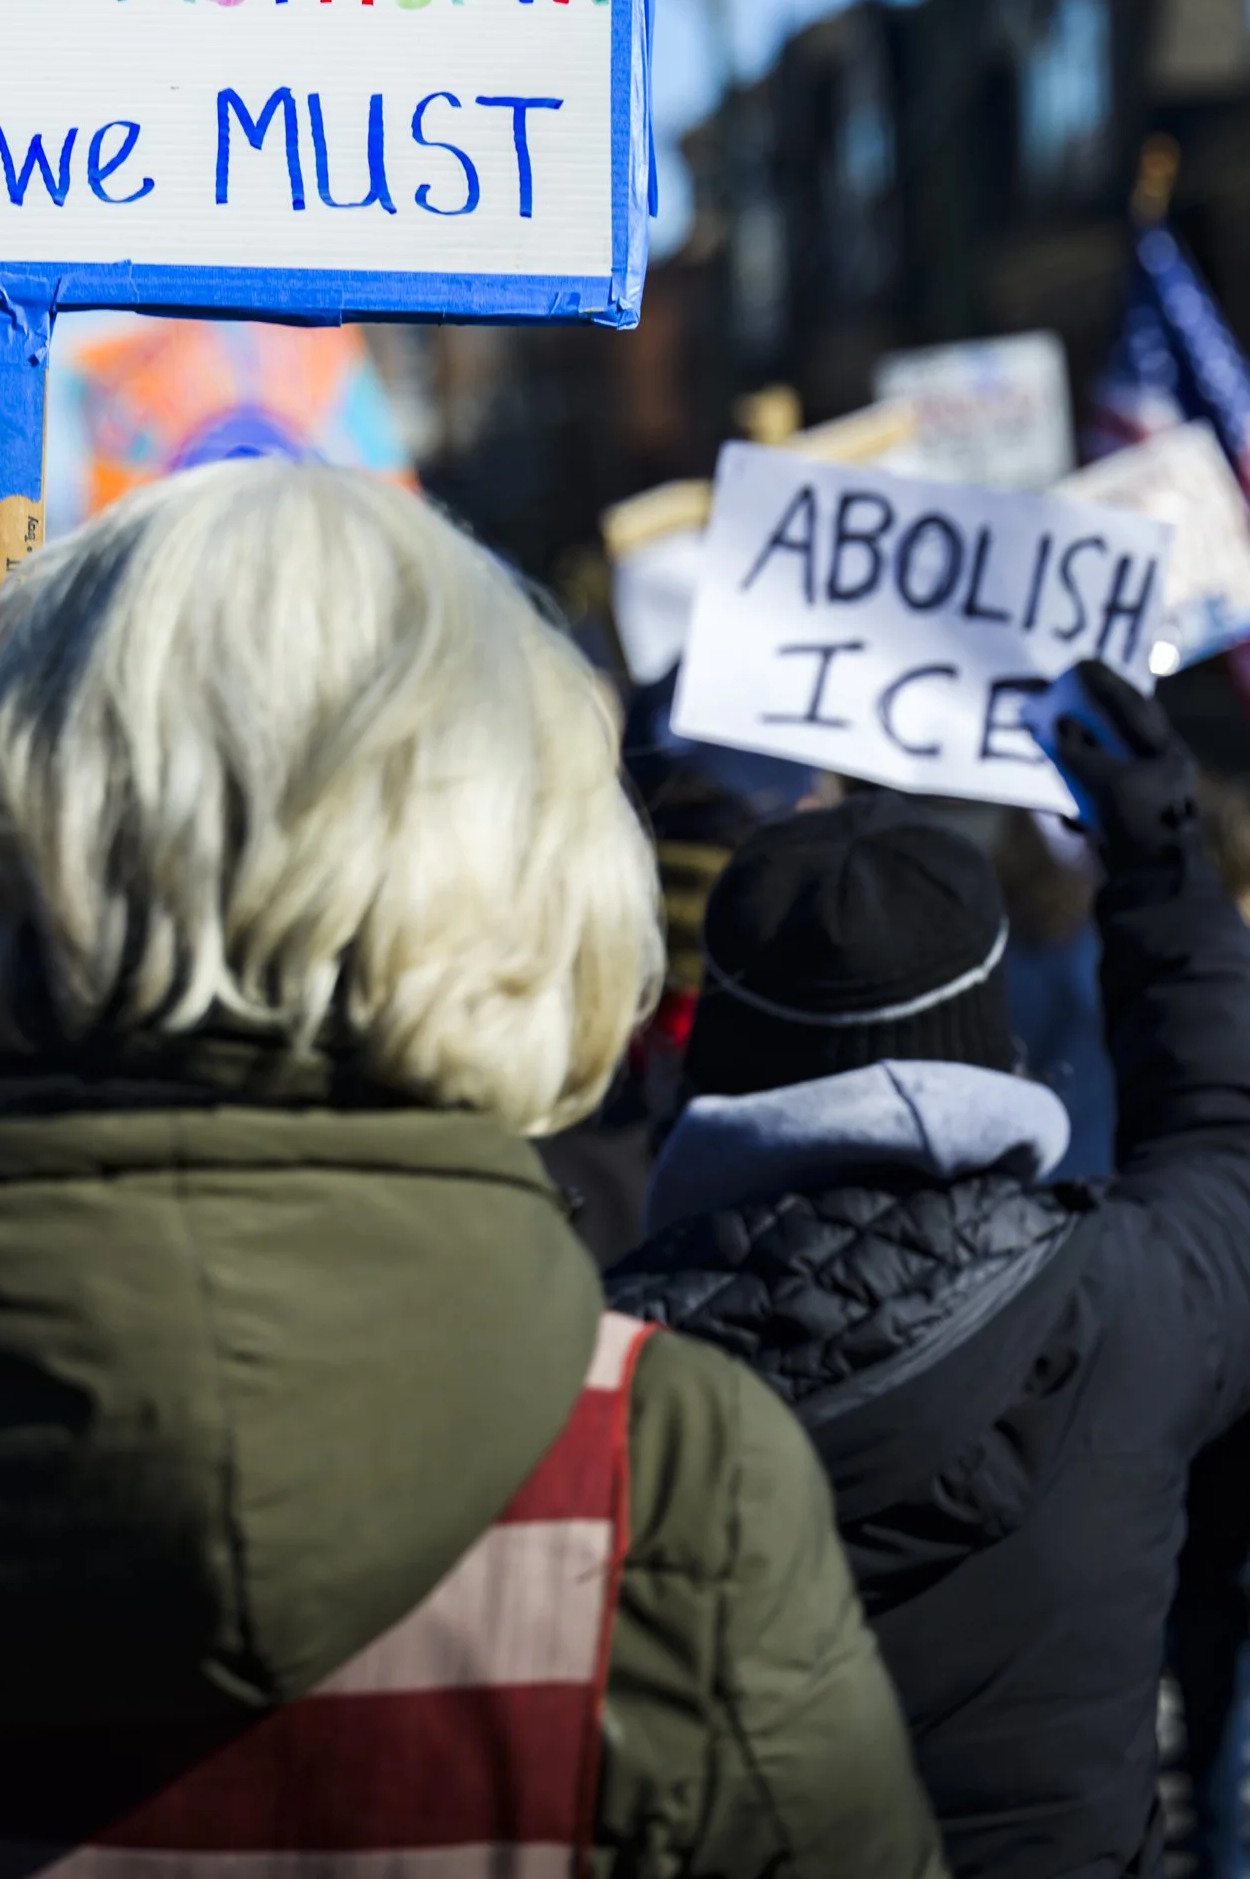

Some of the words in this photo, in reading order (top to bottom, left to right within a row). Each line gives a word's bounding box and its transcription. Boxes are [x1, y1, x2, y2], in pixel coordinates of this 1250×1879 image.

[213, 84, 566, 220] MUST
[740, 482, 1158, 670] ABOLISH
[758, 640, 1050, 764] ICE
